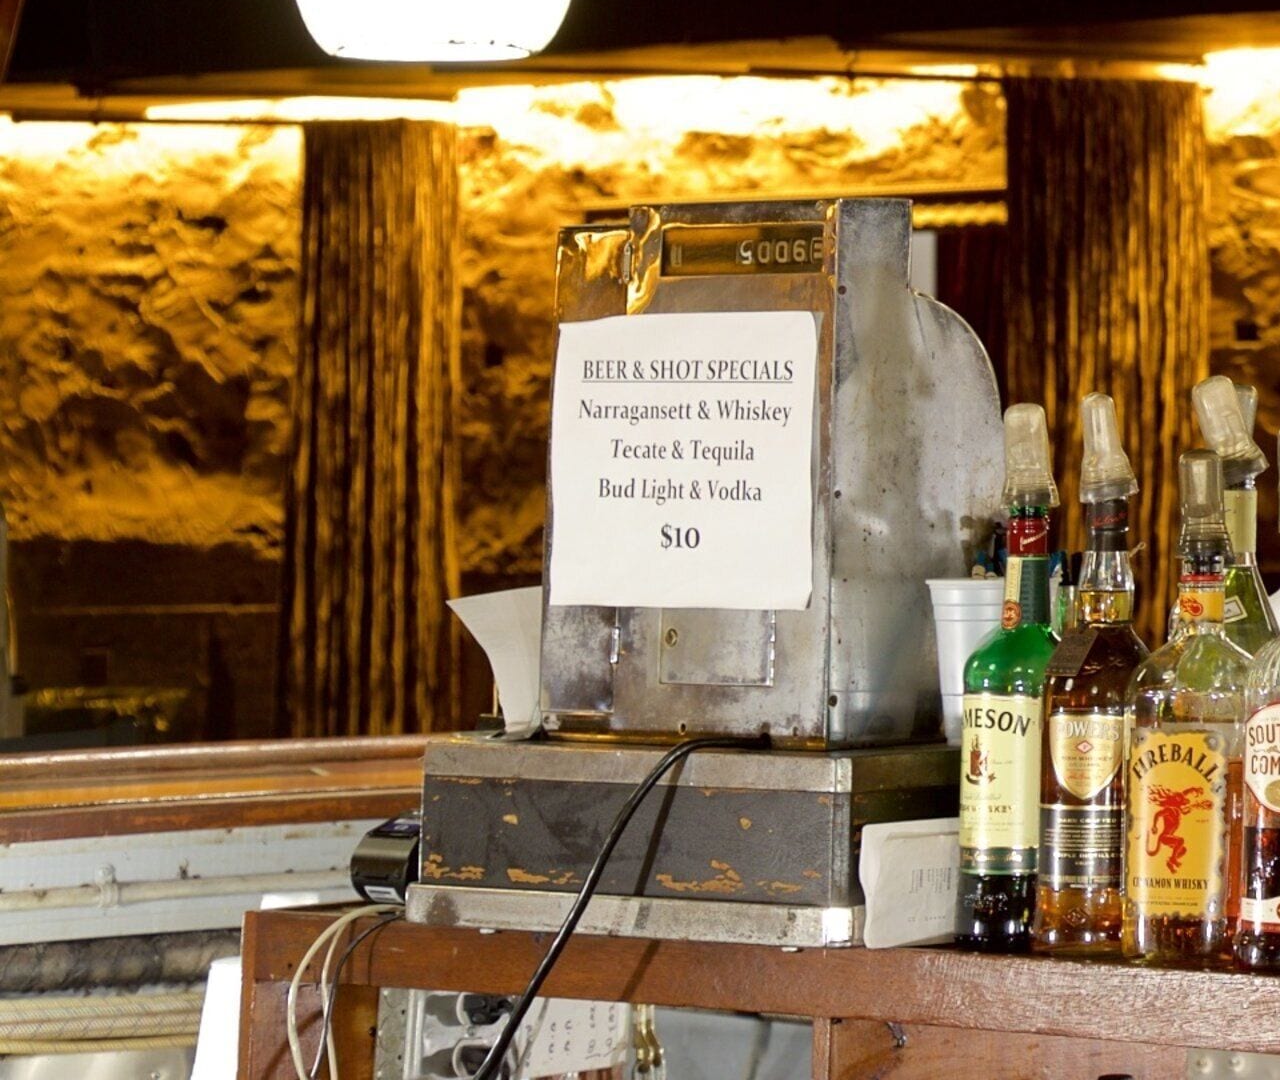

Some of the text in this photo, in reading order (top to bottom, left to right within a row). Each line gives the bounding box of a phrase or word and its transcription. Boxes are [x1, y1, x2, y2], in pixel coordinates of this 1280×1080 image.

[582, 360, 794, 381] BEER & SHOT SPECIALS
[579, 400, 792, 427] Narragansett & Whiskey
[611, 440, 754, 466] Tecate & Tequila
[599, 479, 762, 505] Bud Light & Vodka
[661, 524, 700, 550] $10
[1132, 742, 1220, 783] FIREBALL
[1174, 879, 1209, 890] WHISKY
